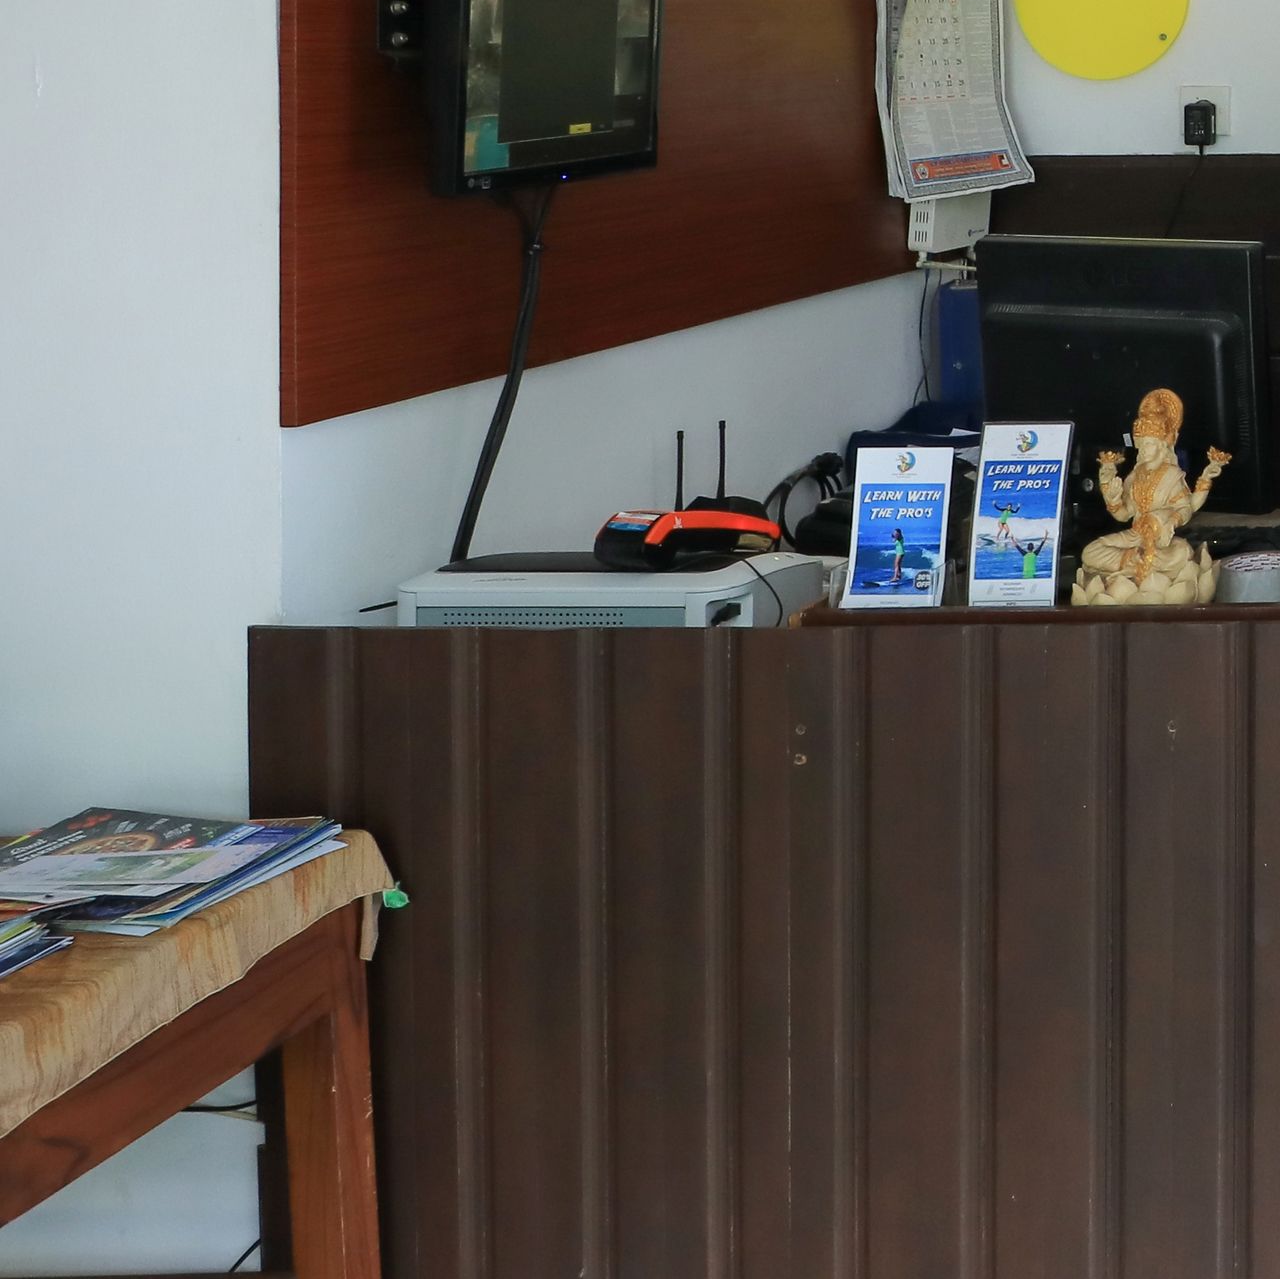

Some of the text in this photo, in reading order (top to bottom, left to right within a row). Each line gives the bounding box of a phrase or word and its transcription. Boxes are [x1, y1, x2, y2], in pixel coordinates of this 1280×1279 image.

[986, 463, 1060, 477] LEARN WITH
[992, 478, 1052, 492] THE PRO'S
[863, 489, 942, 504] LEARN WITH
[870, 507, 934, 520] THE PRO'S
